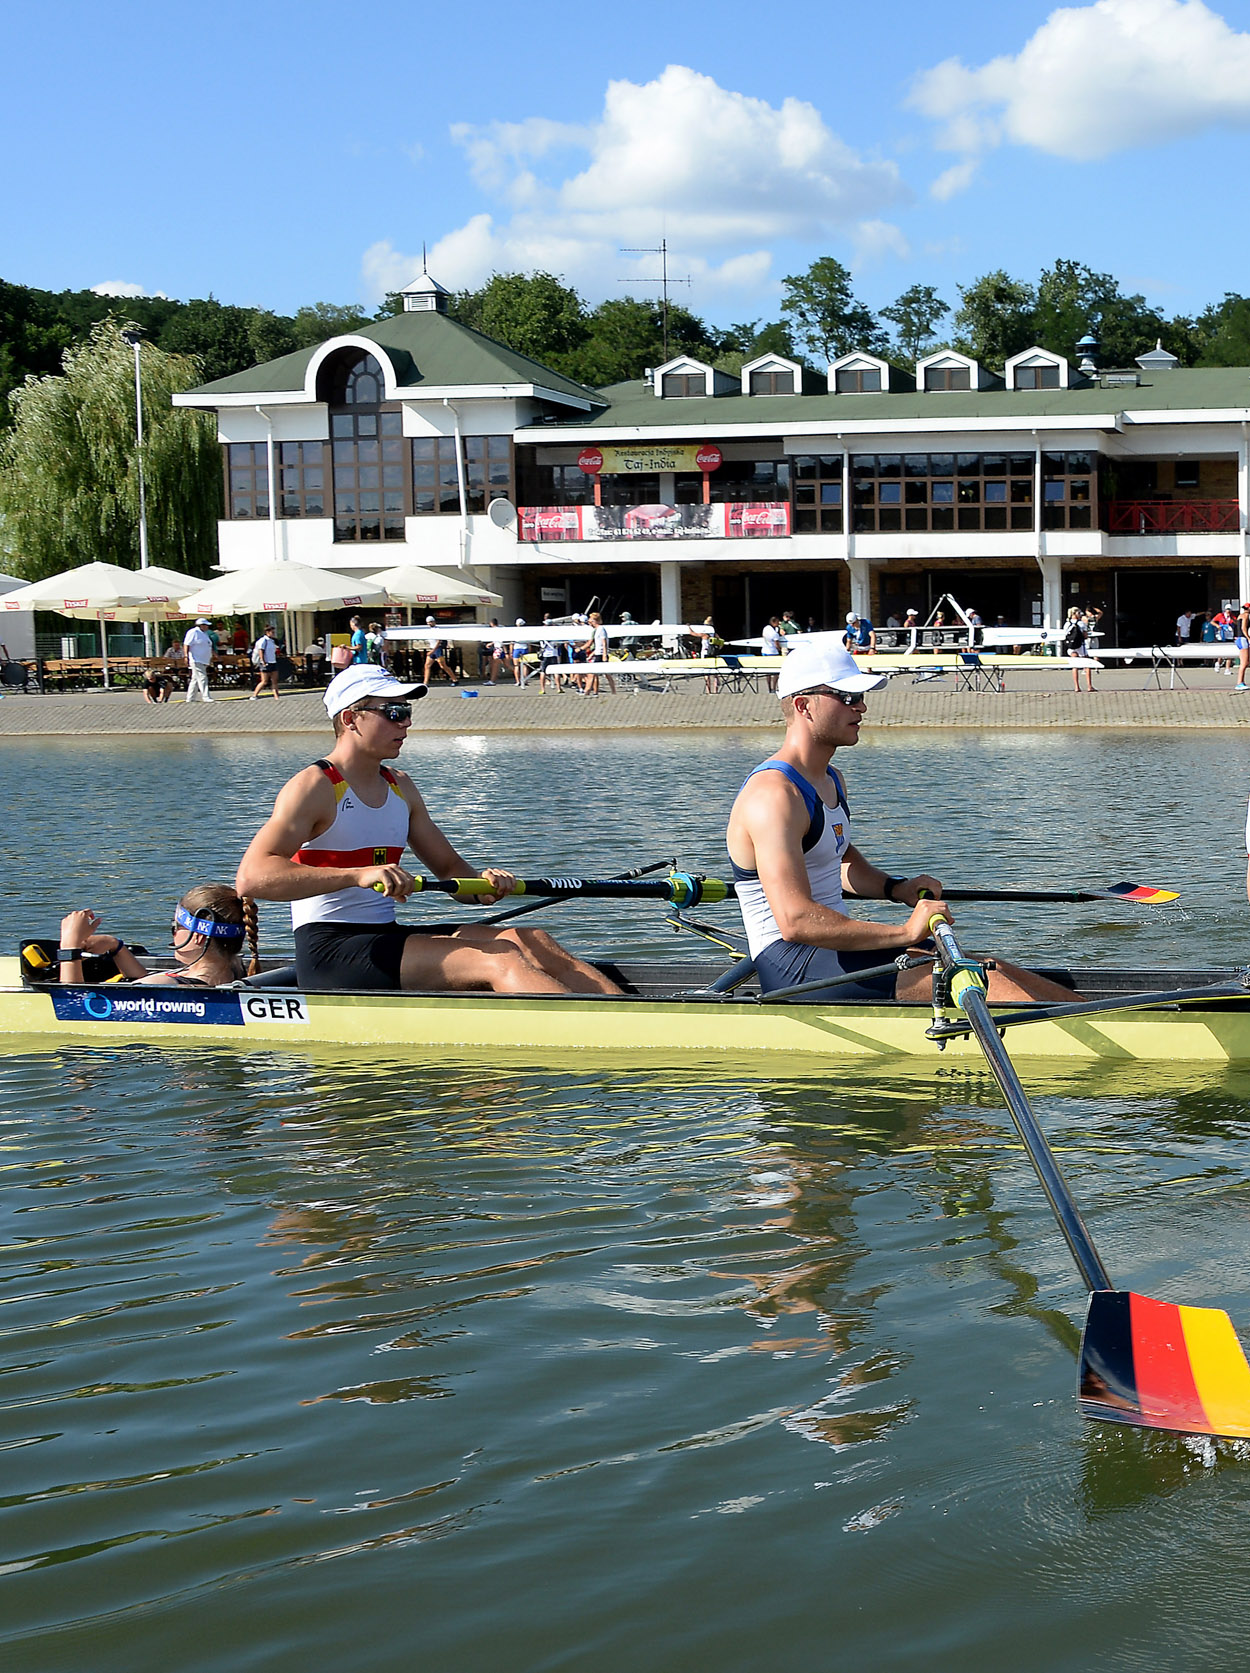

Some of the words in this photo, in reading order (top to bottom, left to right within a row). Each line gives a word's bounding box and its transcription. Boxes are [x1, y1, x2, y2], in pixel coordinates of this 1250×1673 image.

[578, 456, 602, 465] Coca-Cola
[623, 457, 676, 471] Taj-India
[696, 453, 720, 463] Coca-Cola
[196, 921, 211, 933] NK
[215, 925, 229, 935] NK
[114, 998, 155, 1012] world
[156, 1000, 206, 1017] rowing
[247, 997, 305, 1020] GER
